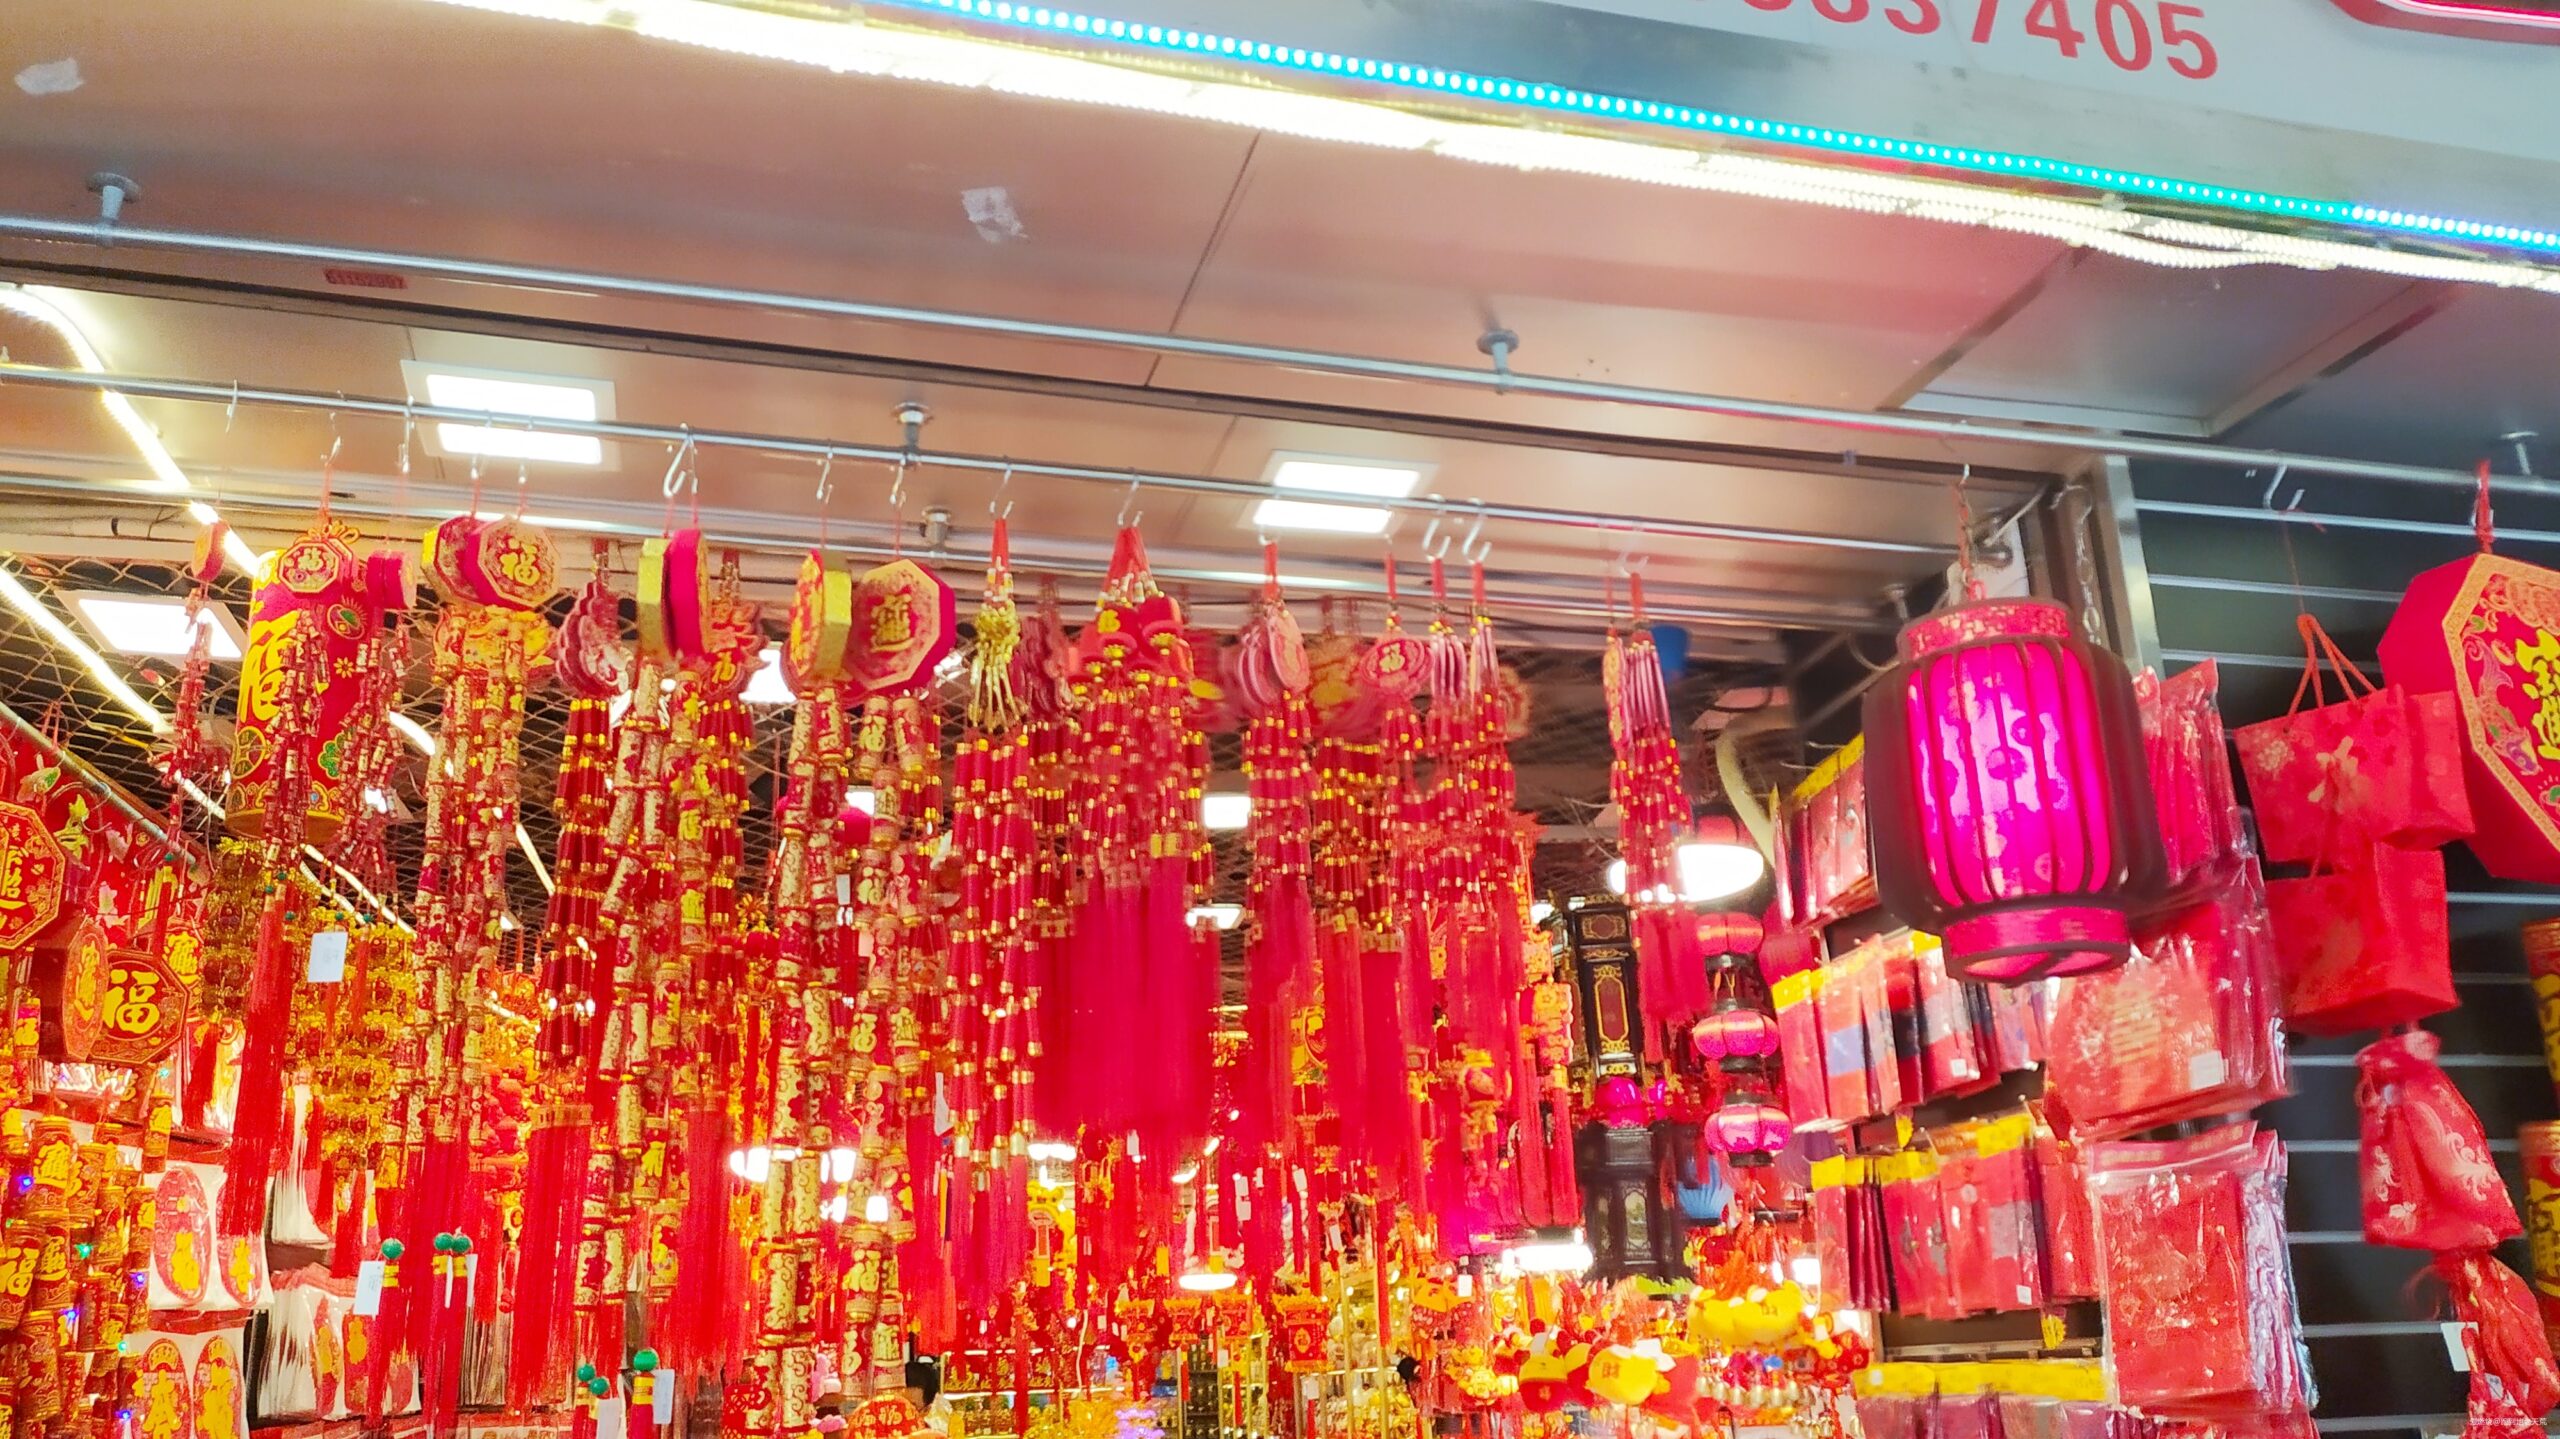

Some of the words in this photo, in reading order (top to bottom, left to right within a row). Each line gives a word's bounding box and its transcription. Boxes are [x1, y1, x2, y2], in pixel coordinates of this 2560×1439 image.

[1743, 0, 2220, 79] 37405
[500, 538, 541, 586] 福
[102, 968, 161, 1034] 福
